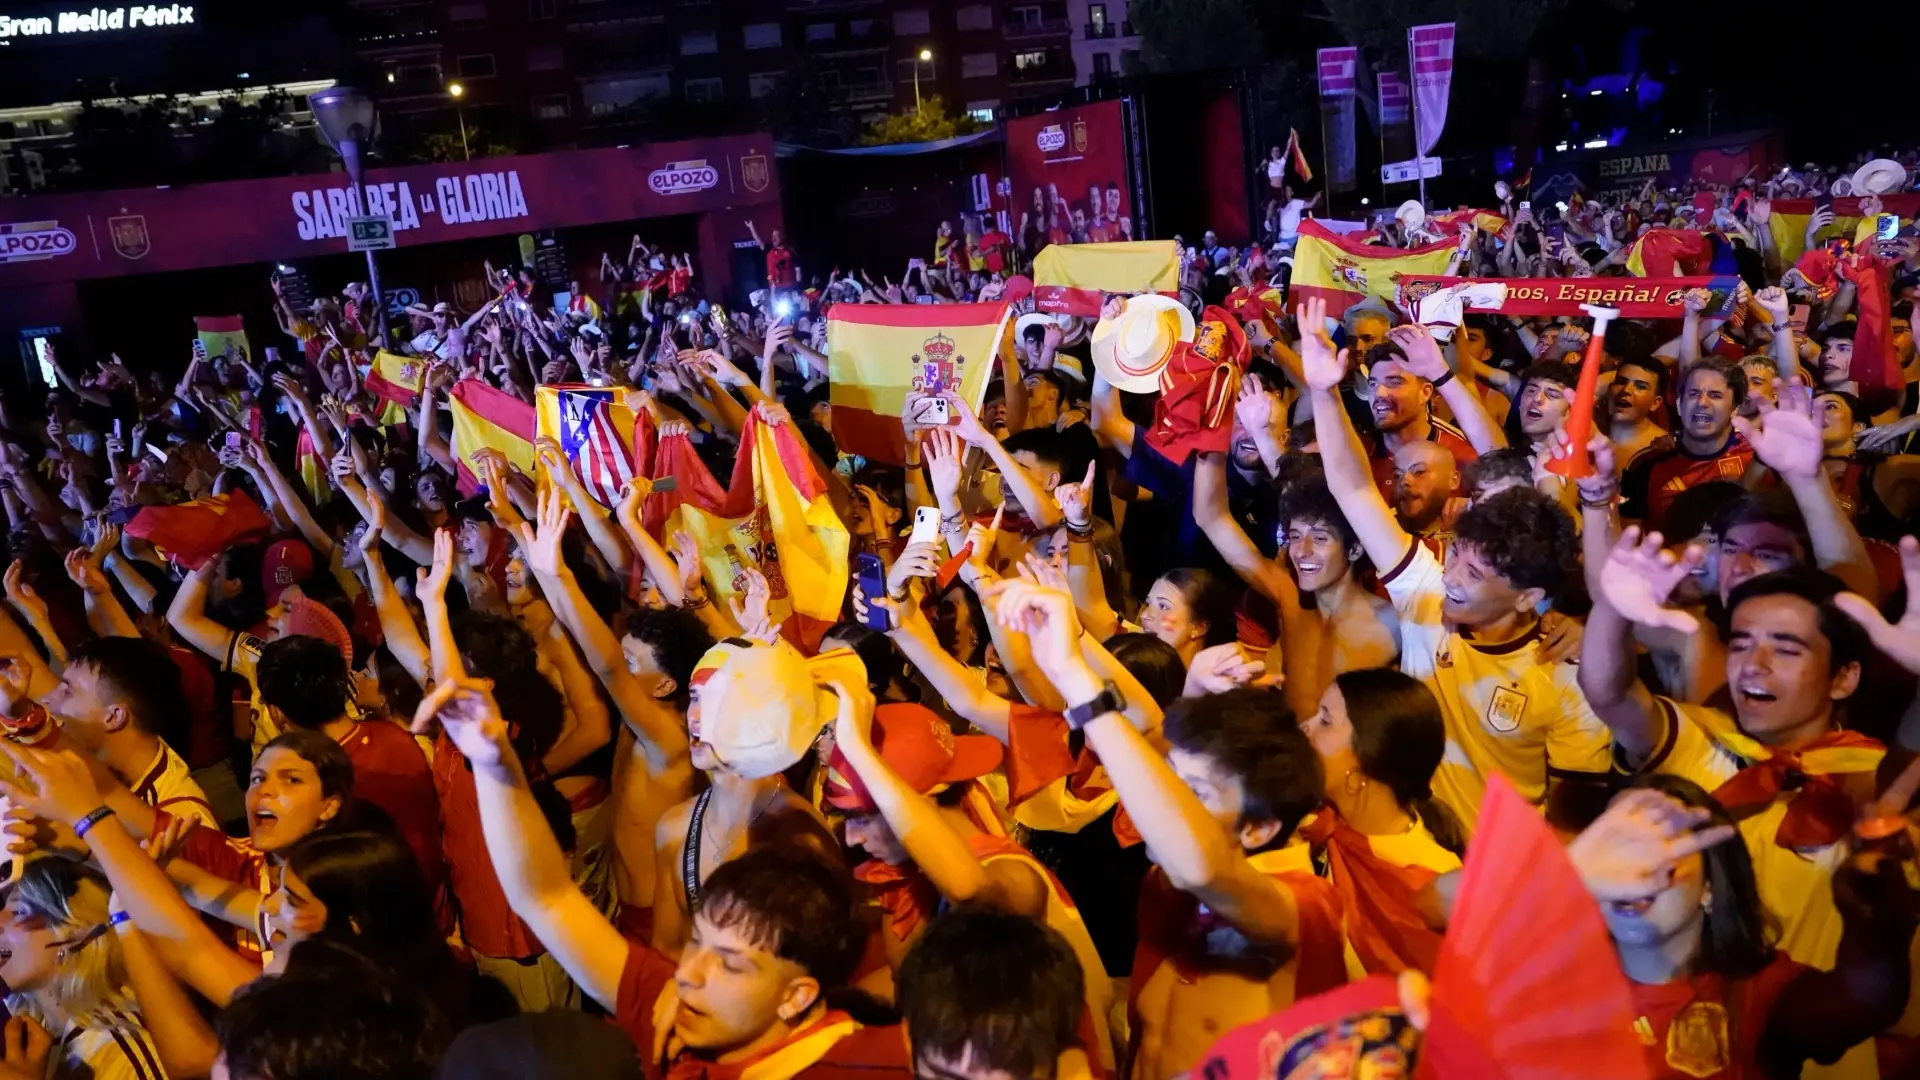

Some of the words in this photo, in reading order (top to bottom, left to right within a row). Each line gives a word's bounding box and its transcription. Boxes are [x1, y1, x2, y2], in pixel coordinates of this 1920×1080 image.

[0, 15, 52, 37] Gran
[129, 3, 194, 28] Fénix
[420, 193, 435, 213] LA
[436, 170, 528, 225] GLORIA
[0, 232, 71, 254] LPOZO
[1039, 300, 1069, 309] mapfre
[1556, 285, 1661, 305] España!
